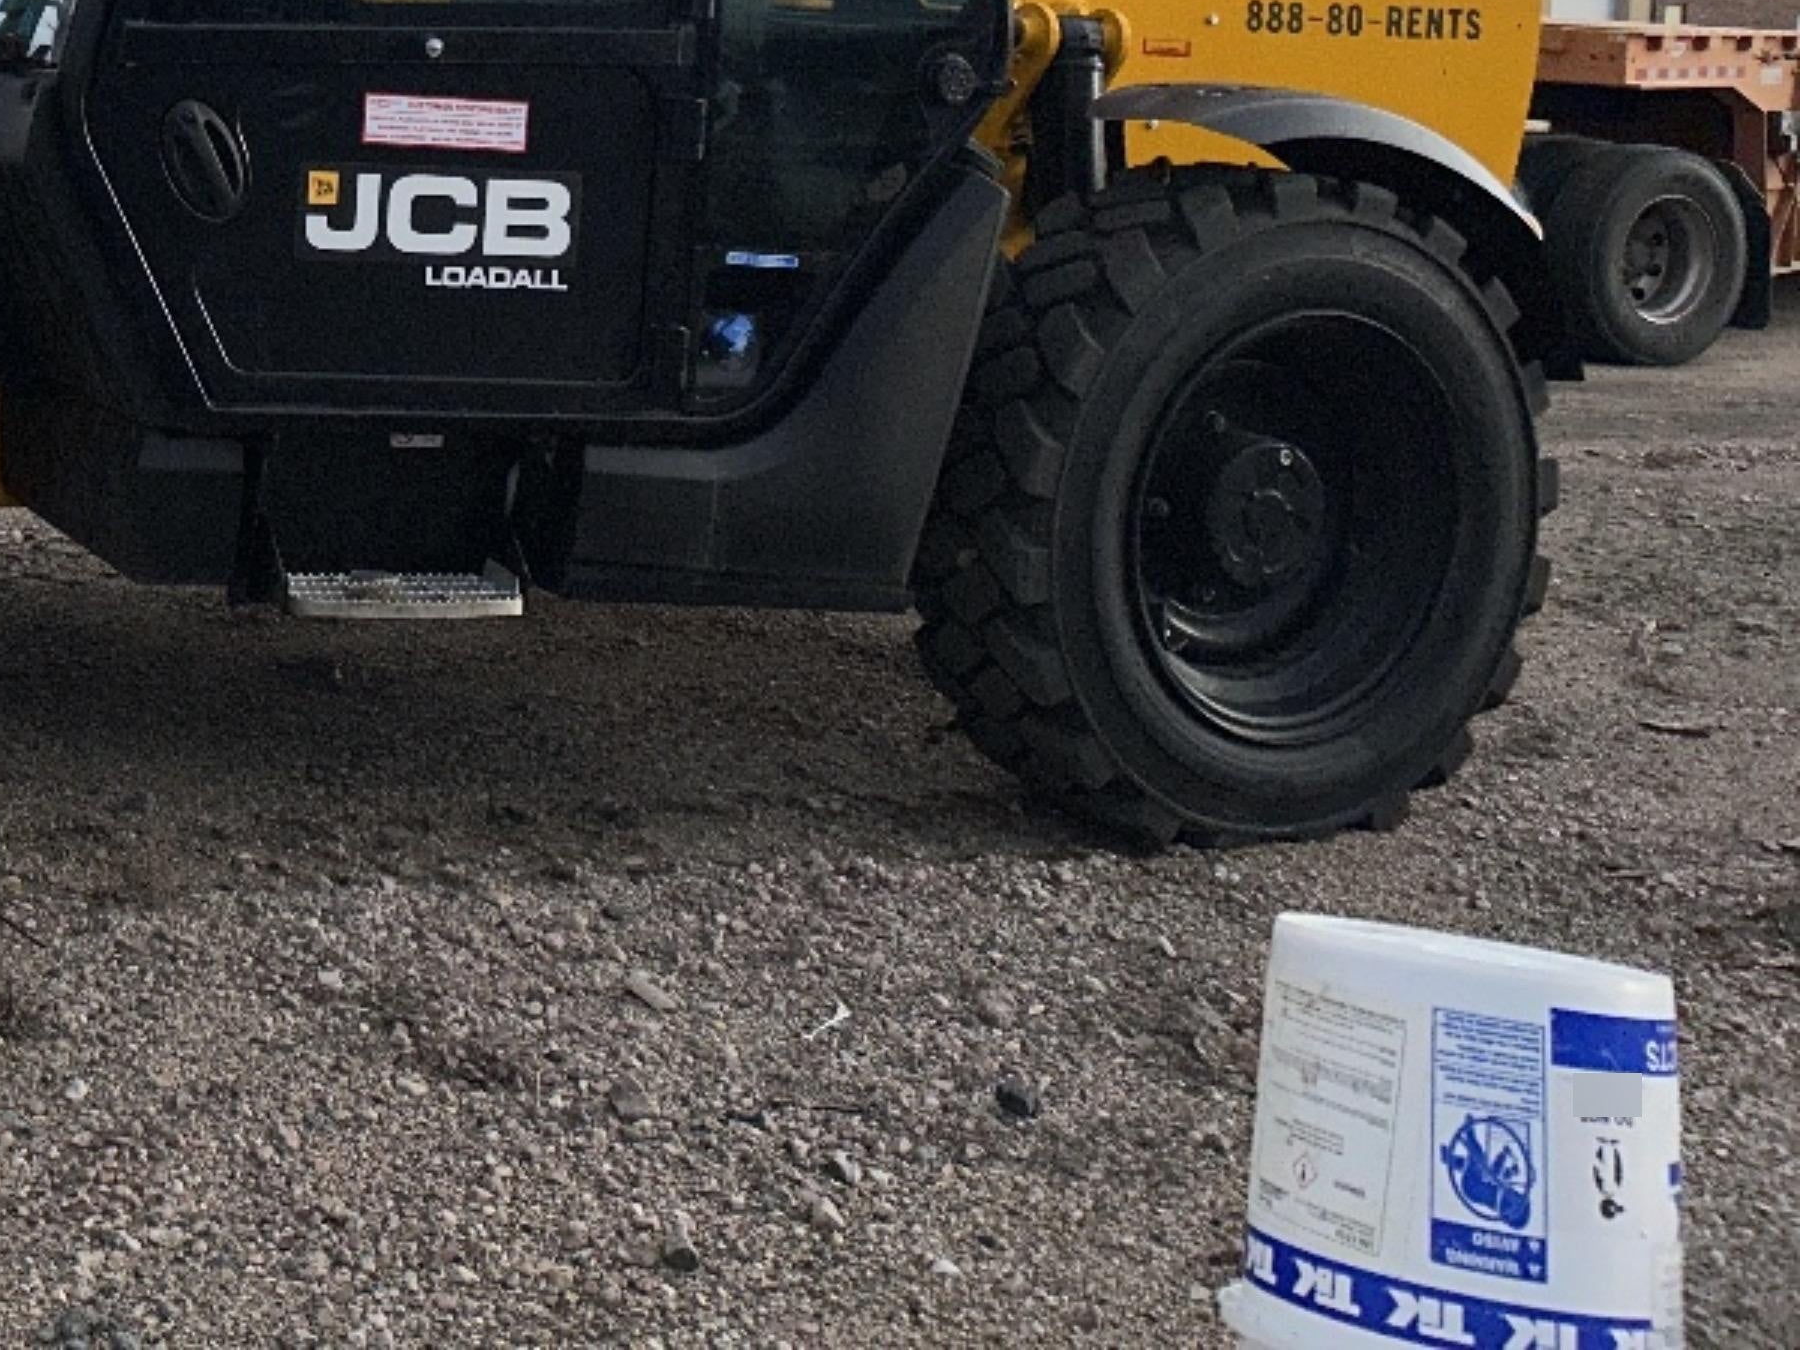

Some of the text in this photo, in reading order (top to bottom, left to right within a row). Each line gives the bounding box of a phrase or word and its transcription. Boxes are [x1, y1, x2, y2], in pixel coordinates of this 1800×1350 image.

[1246, 0, 1482, 41] 888-80-RENTS
[305, 172, 572, 257] JCB
[424, 265, 569, 291] LOADALL
